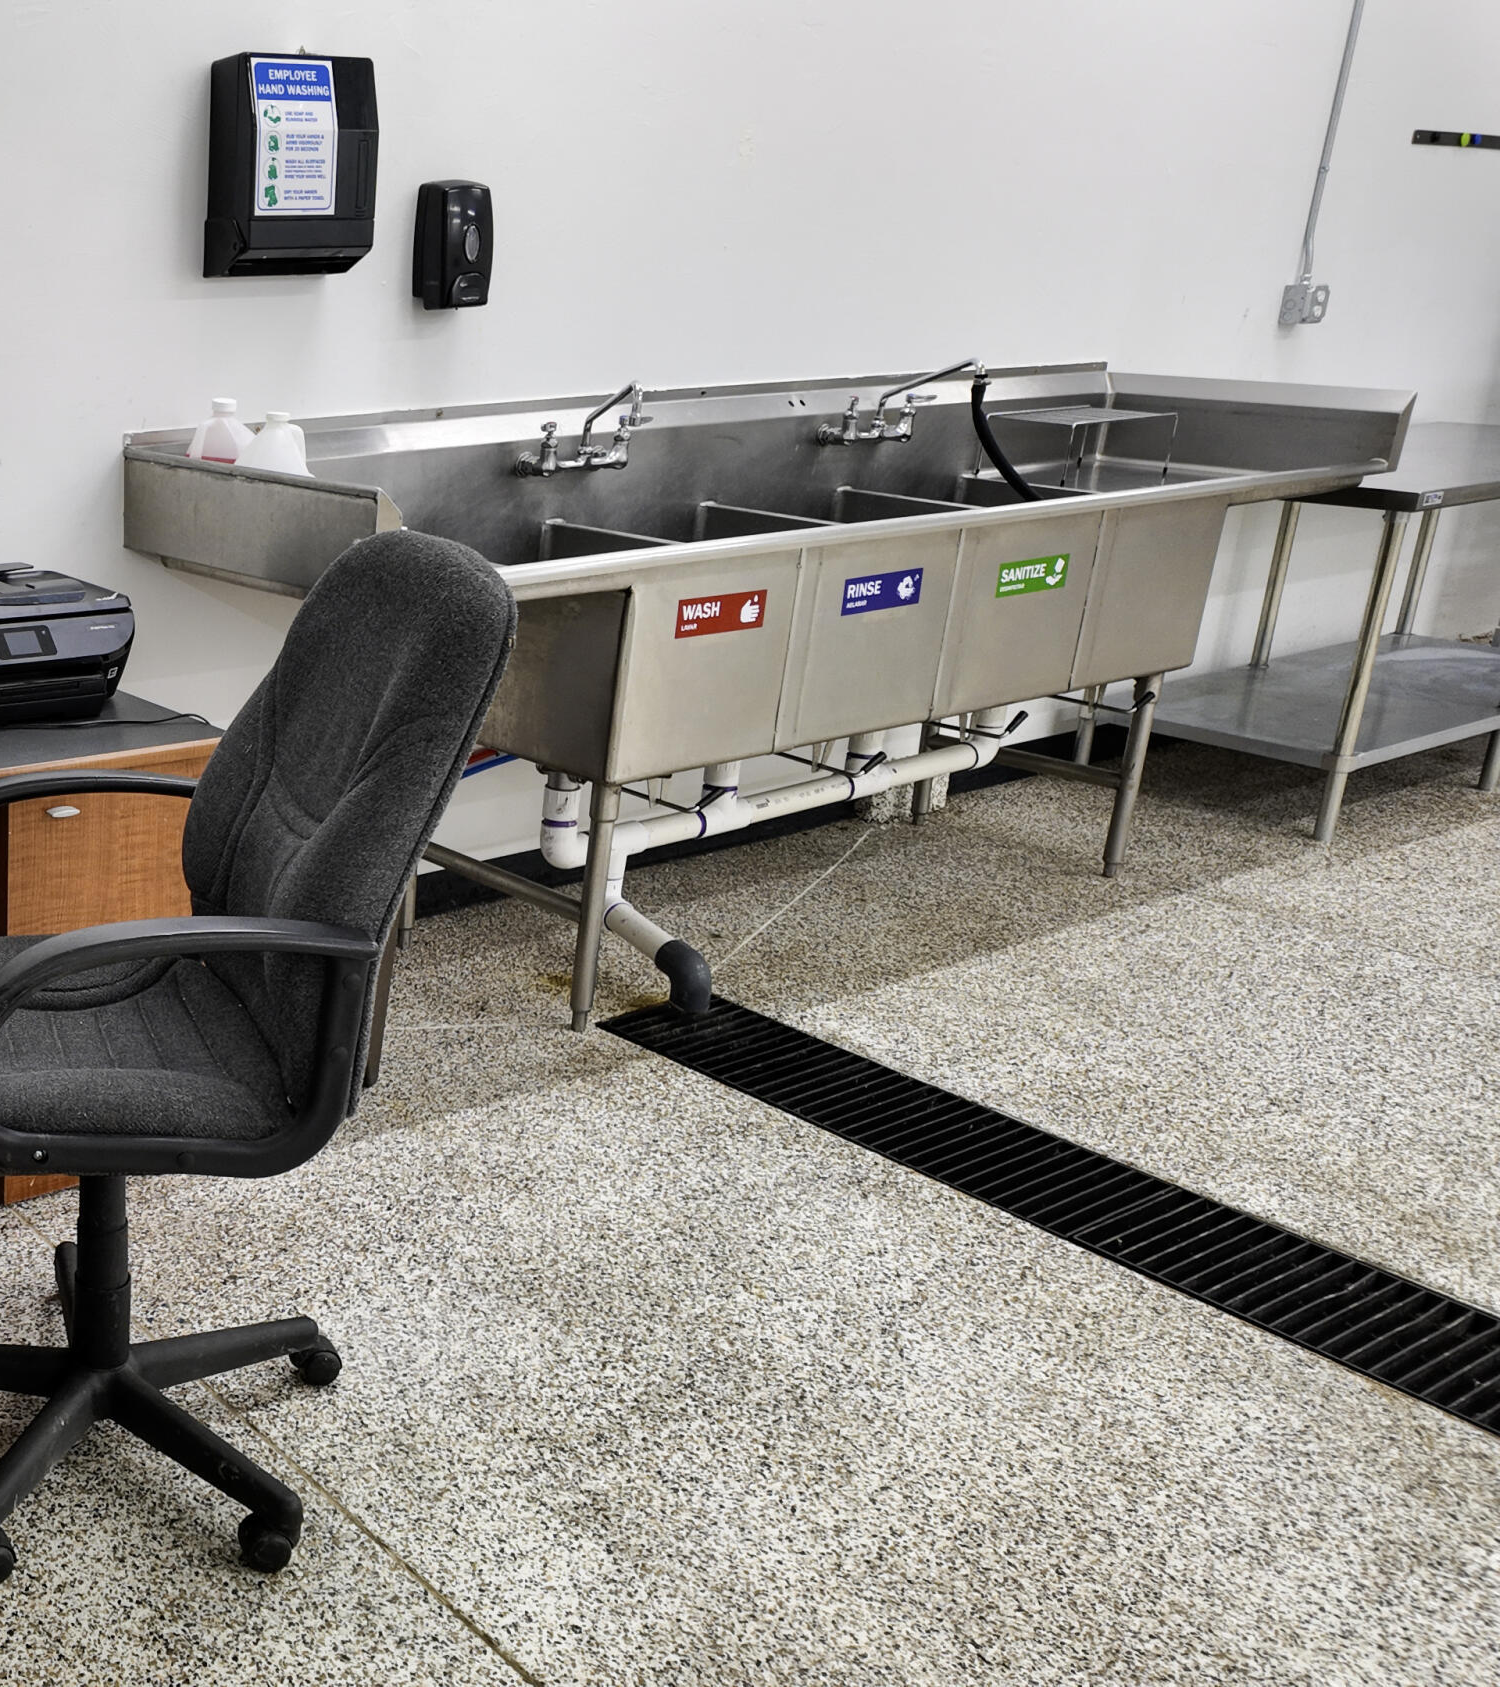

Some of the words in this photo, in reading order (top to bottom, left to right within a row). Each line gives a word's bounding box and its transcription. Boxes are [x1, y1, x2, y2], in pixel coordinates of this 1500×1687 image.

[268, 69, 318, 82] EMPLOYEE
[258, 83, 285, 95] HAND
[286, 84, 330, 97] WASHING
[1000, 563, 1048, 584] SANITIZE
[847, 580, 883, 600] RINSE
[682, 601, 722, 621] WASH
